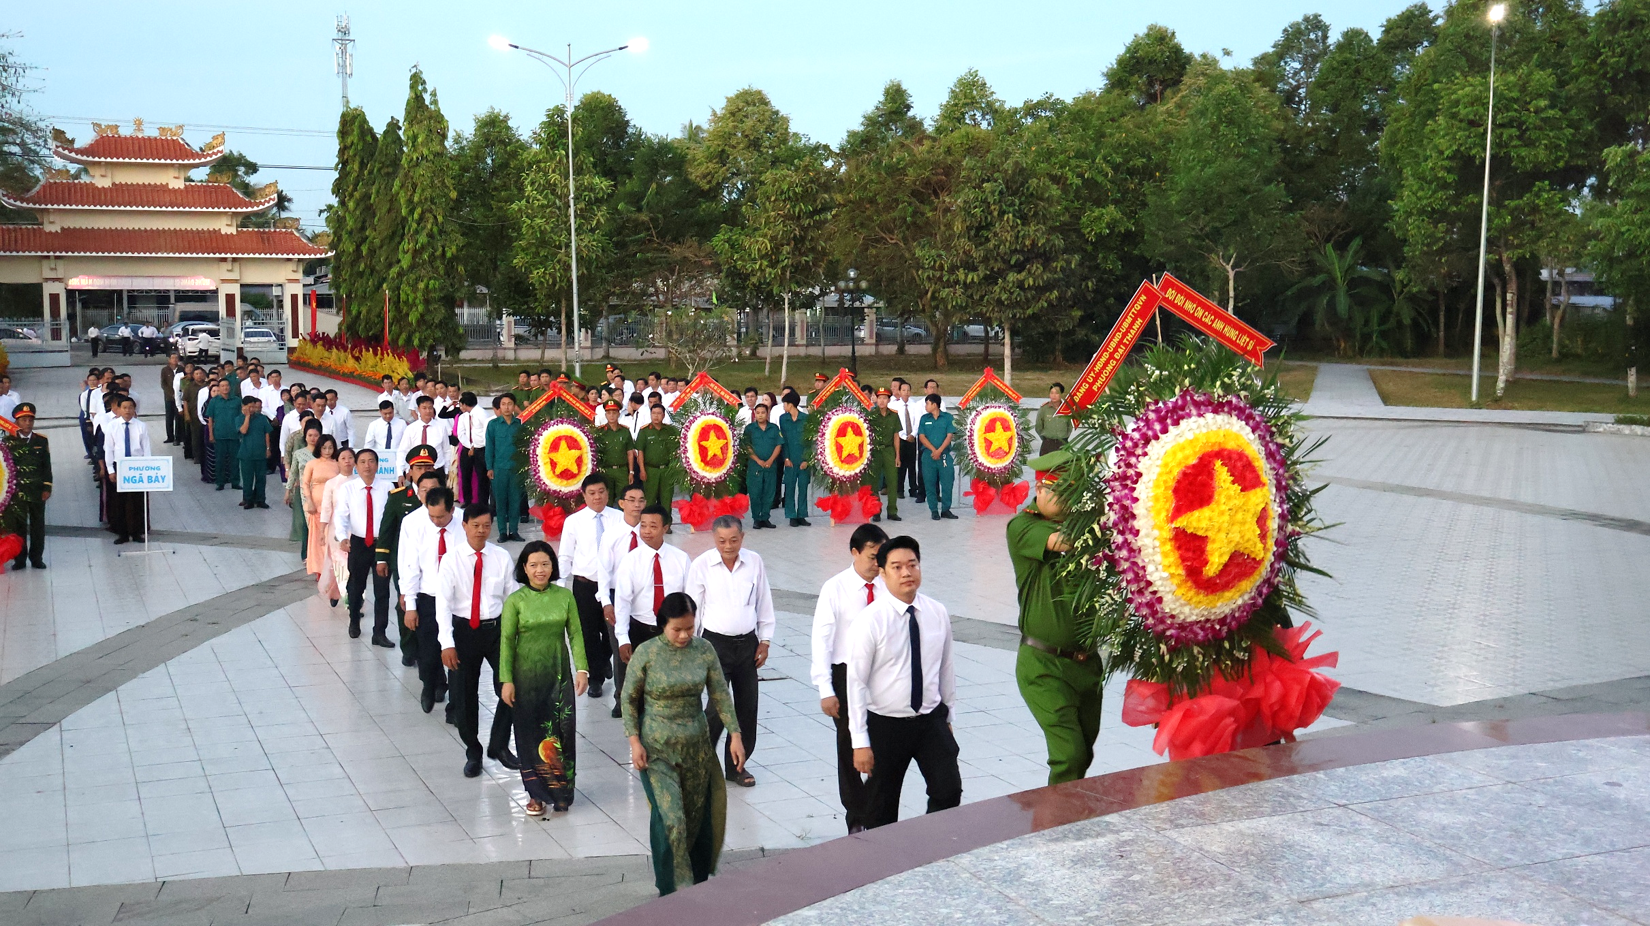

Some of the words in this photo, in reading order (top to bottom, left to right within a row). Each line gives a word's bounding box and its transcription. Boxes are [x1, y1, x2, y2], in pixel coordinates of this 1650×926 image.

[1211, 318, 1226, 332] ANH
[122, 473, 144, 484] NGÃ
[147, 472, 166, 484] BẢY
